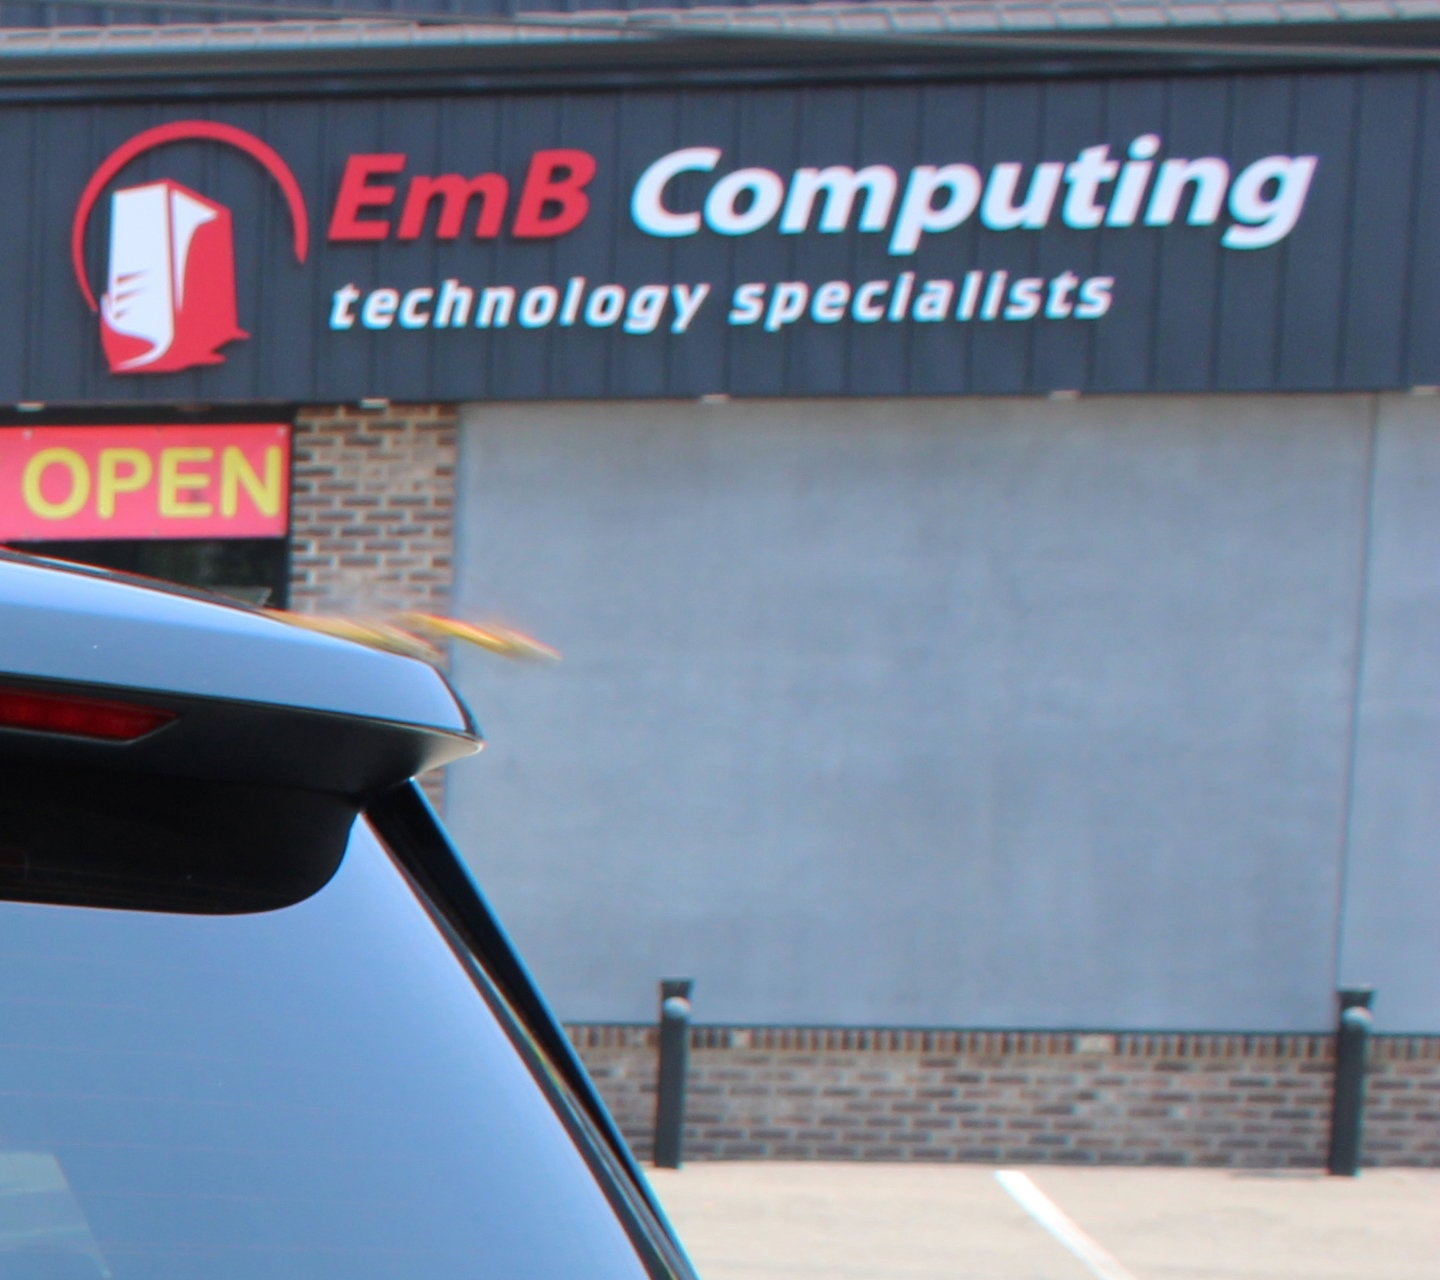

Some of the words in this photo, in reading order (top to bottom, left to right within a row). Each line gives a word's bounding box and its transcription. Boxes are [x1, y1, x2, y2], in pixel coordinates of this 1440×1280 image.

[327, 148, 598, 241] EmB
[630, 133, 1318, 252] Computing
[329, 275, 711, 335] technology
[728, 269, 1116, 332] specialists
[21, 445, 282, 520] OPEN
